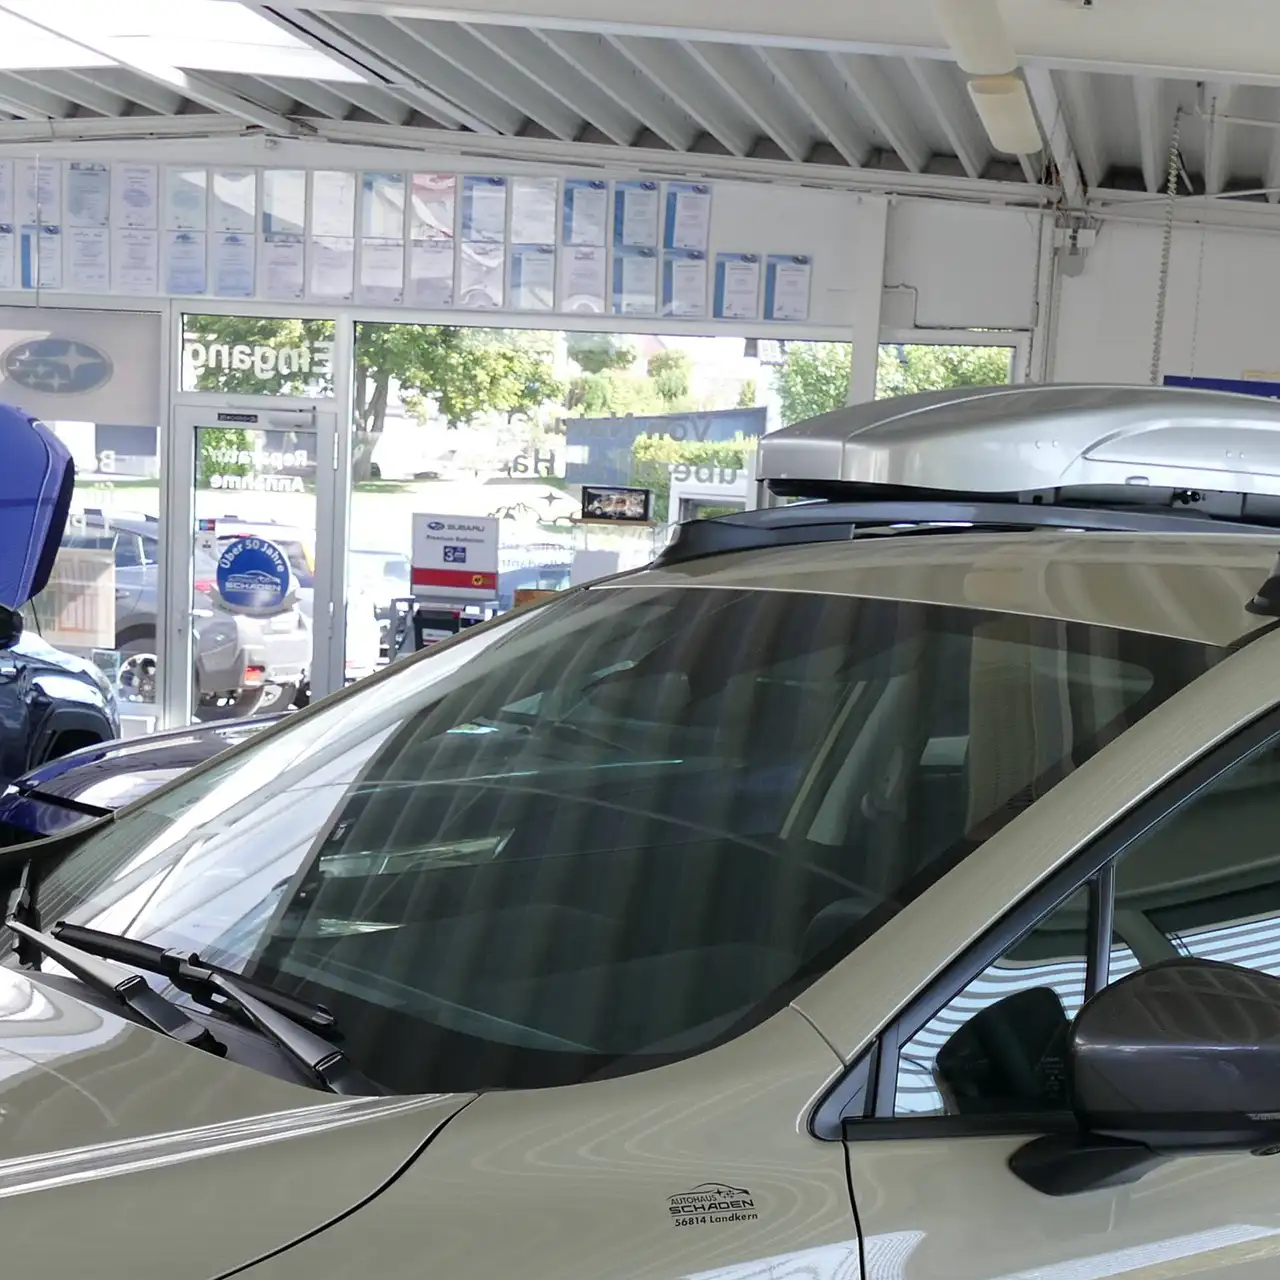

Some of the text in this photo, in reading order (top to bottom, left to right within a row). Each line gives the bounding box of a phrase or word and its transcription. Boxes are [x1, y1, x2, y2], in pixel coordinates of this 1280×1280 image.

[446, 523, 486, 532] SUBARU
[219, 539, 285, 572] Über 50 Jahre
[445, 547, 455, 561] 3
[225, 581, 281, 591] SCHADEN
[669, 1199, 755, 1215] SCHADEN
[671, 1195, 718, 1206] AUTOHAUS
[675, 1212, 758, 1227] 56814 Landkern
